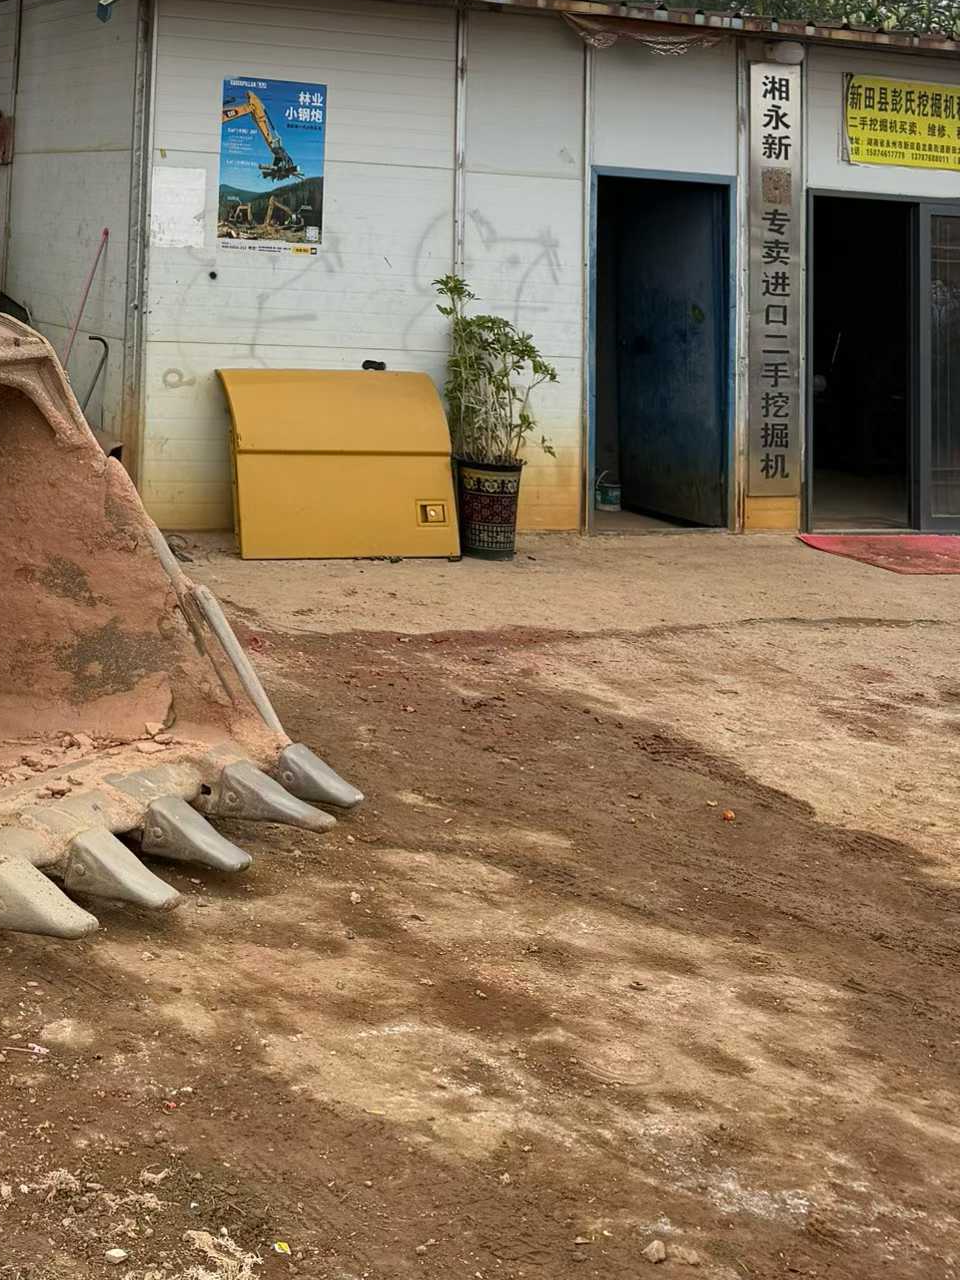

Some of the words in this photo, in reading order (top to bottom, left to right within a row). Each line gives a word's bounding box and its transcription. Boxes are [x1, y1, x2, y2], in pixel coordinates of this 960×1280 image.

[285, 106, 323, 123] 小钢炮
[298, 91, 324, 106] 林业
[849, 83, 960, 120] 新田县彭氏挖掘机
[762, 75, 792, 161] 湘永新
[760, 208, 791, 480] 专卖进口二手挖掘机
